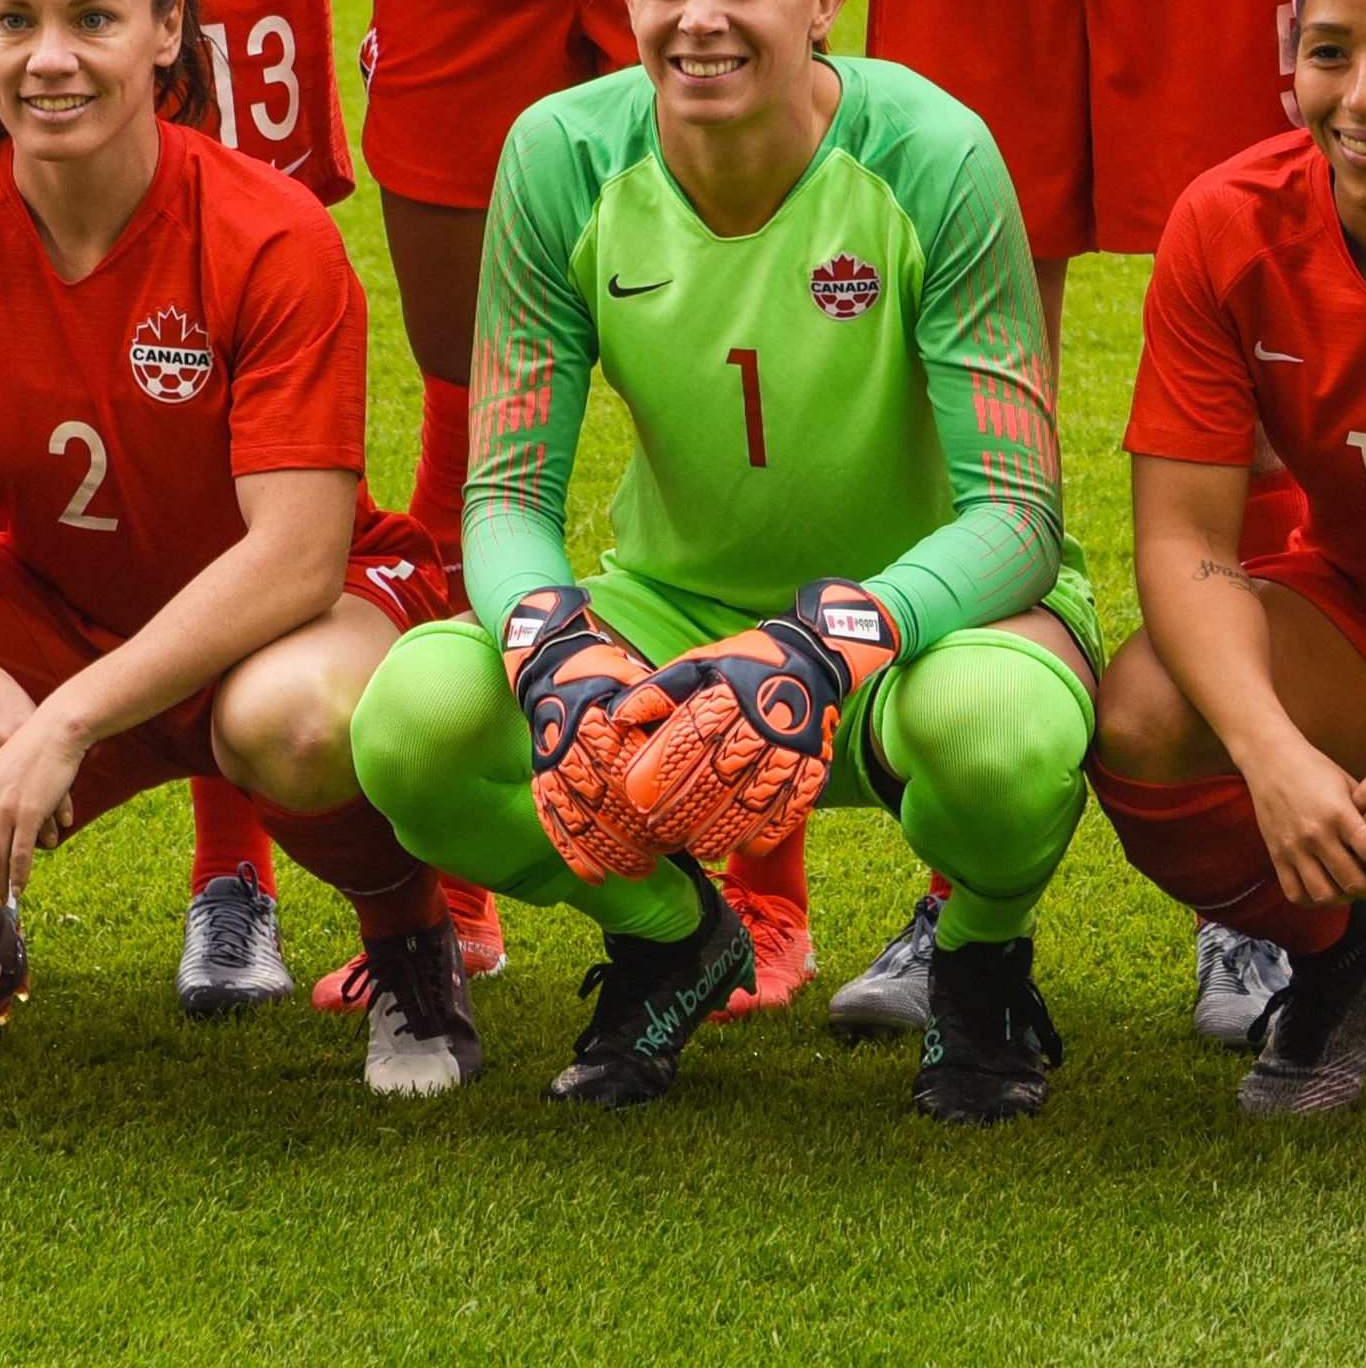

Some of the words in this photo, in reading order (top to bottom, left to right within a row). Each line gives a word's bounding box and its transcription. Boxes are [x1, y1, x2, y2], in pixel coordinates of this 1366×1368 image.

[196, 15, 299, 150] 13
[810, 281, 879, 293] CANADA
[132, 347, 210, 367] CANADA
[726, 348, 766, 468] 1
[49, 420, 119, 531] 2
[633, 1000, 681, 1057] new
[675, 927, 749, 1016] balance
